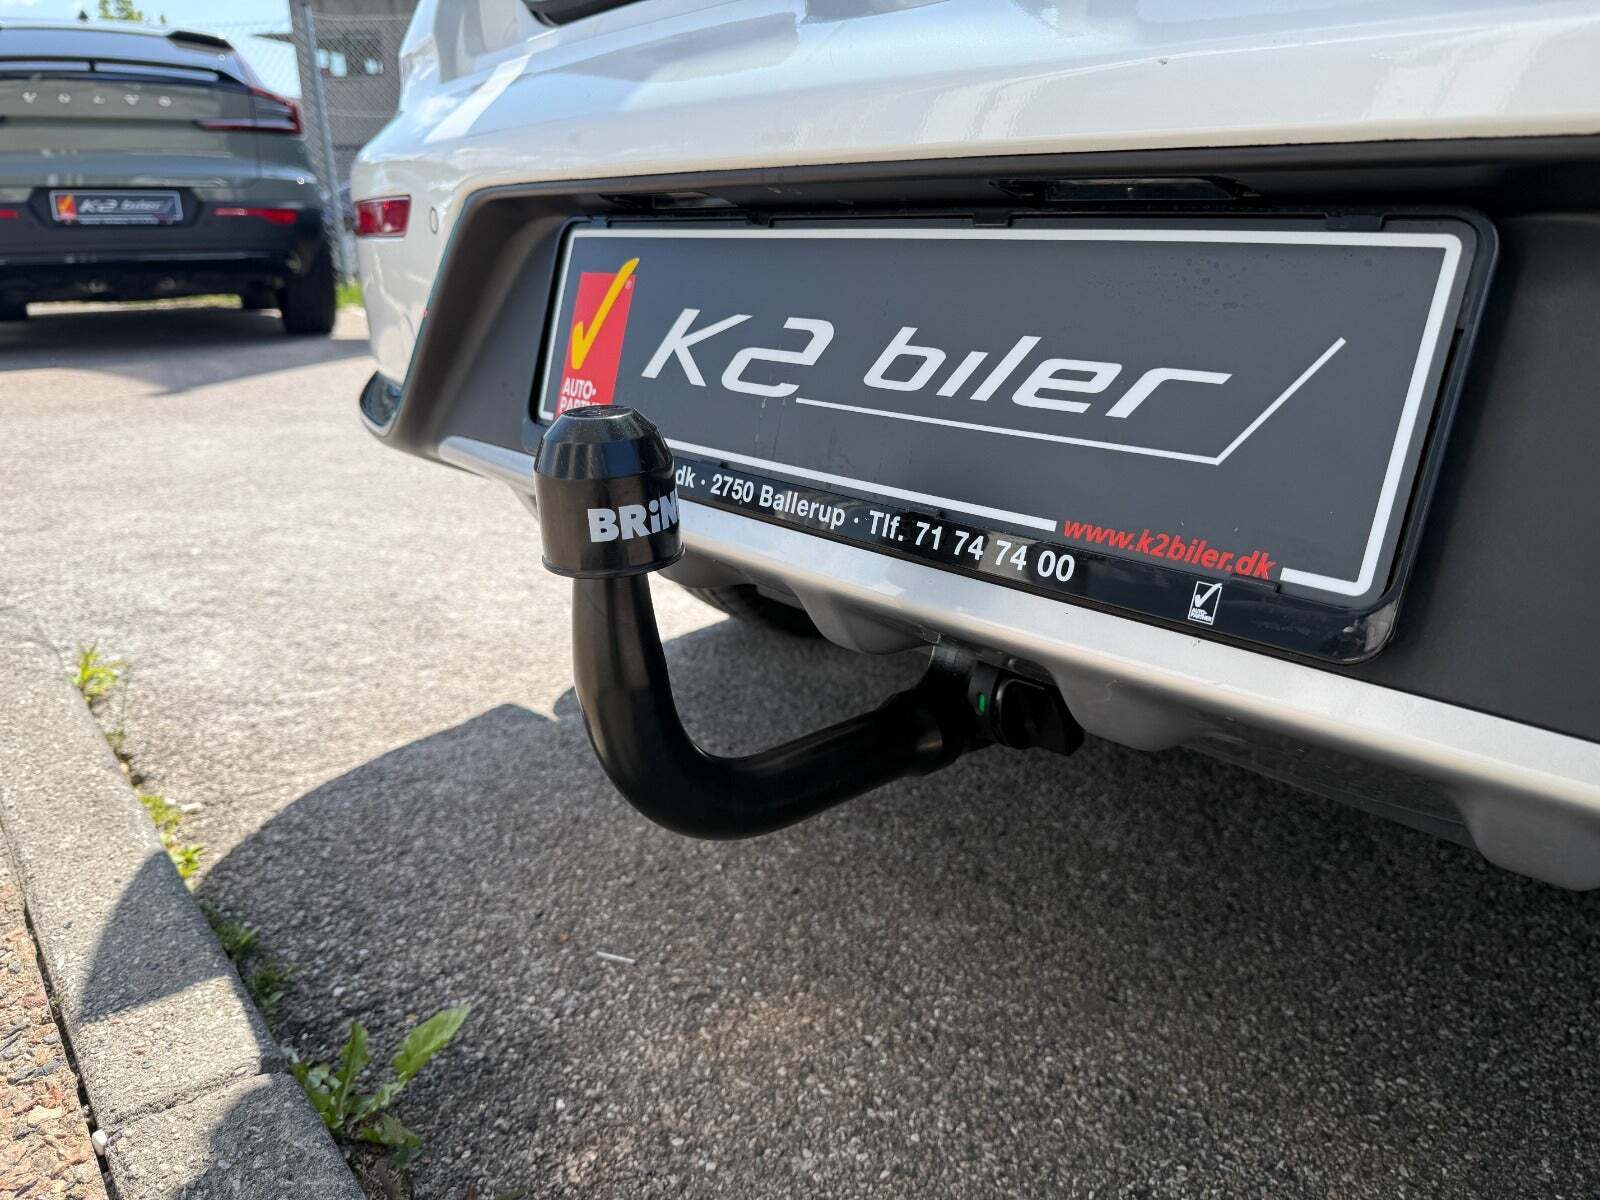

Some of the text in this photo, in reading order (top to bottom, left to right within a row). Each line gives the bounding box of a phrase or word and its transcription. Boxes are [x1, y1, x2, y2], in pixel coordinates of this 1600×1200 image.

[641, 308, 1233, 419] K2 biler
[710, 473, 754, 504] 2750
[758, 484, 846, 530] Ballerup
[869, 510, 904, 542] Tlf.
[915, 521, 943, 551] 71
[953, 530, 985, 561] 74
[995, 539, 1028, 571] 74
[1037, 550, 1075, 582] 00
[1063, 519, 1277, 582] www.k2biler.dk
